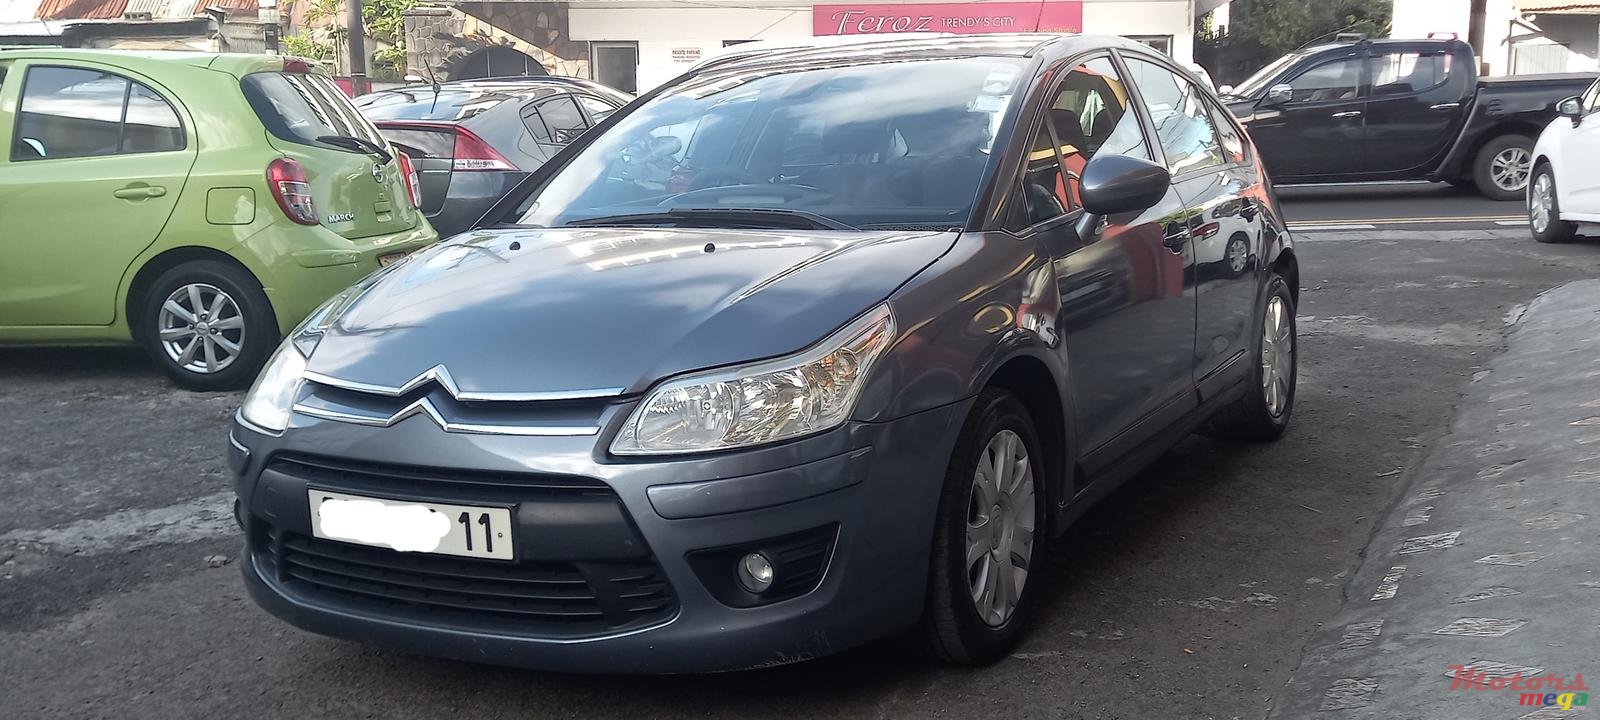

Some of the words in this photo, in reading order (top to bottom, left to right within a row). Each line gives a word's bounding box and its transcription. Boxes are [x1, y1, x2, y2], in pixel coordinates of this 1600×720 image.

[832, 10, 933, 35] Feroz
[941, 17, 990, 28] TRENDY'S
[992, 16, 1016, 27] CITY
[328, 211, 354, 224] MARCH
[458, 511, 493, 552] 11
